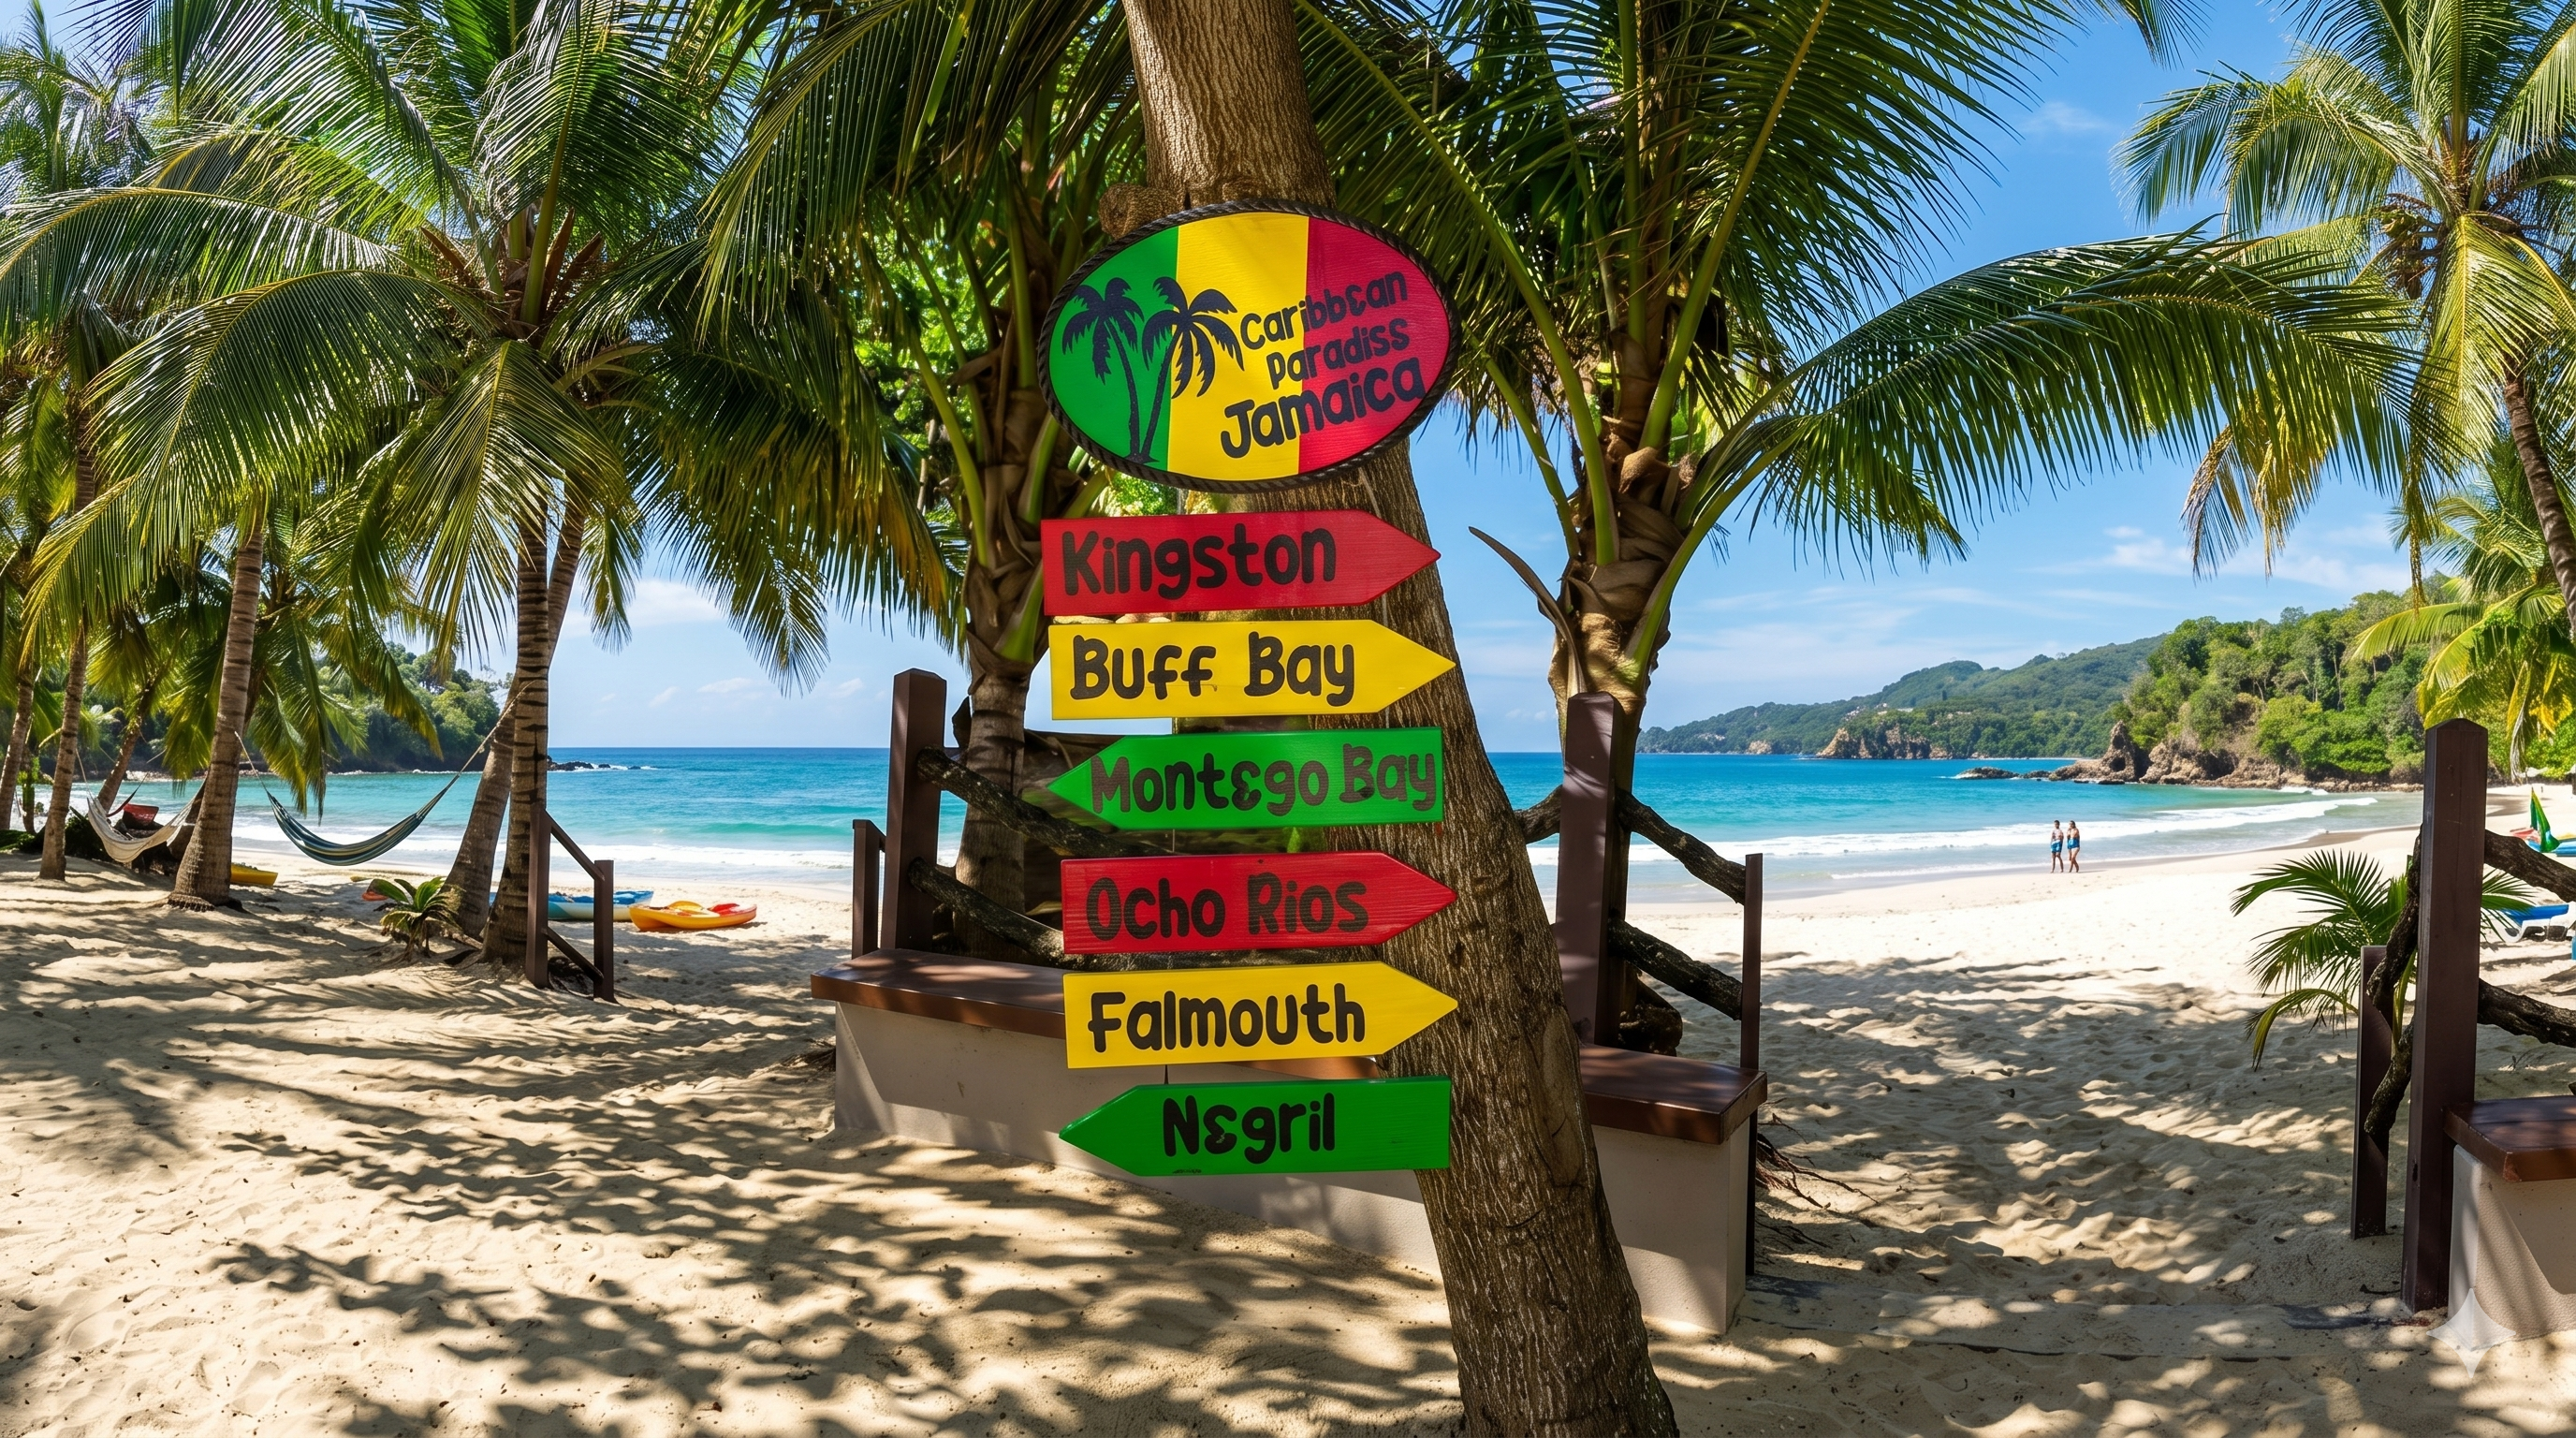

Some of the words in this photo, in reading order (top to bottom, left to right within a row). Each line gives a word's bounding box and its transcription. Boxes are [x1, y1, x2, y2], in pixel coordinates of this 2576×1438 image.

[1221, 357, 1427, 459] Jamaica
[1061, 523, 1337, 600] Kingston
[1070, 635, 1217, 700] Buff
[1243, 631, 1354, 707] Bay
[1339, 743, 1438, 813] Bay
[1086, 877, 1226, 941] Ocho
[1247, 872, 1369, 935] Rios
[1088, 983, 1366, 1053] Falmouth
